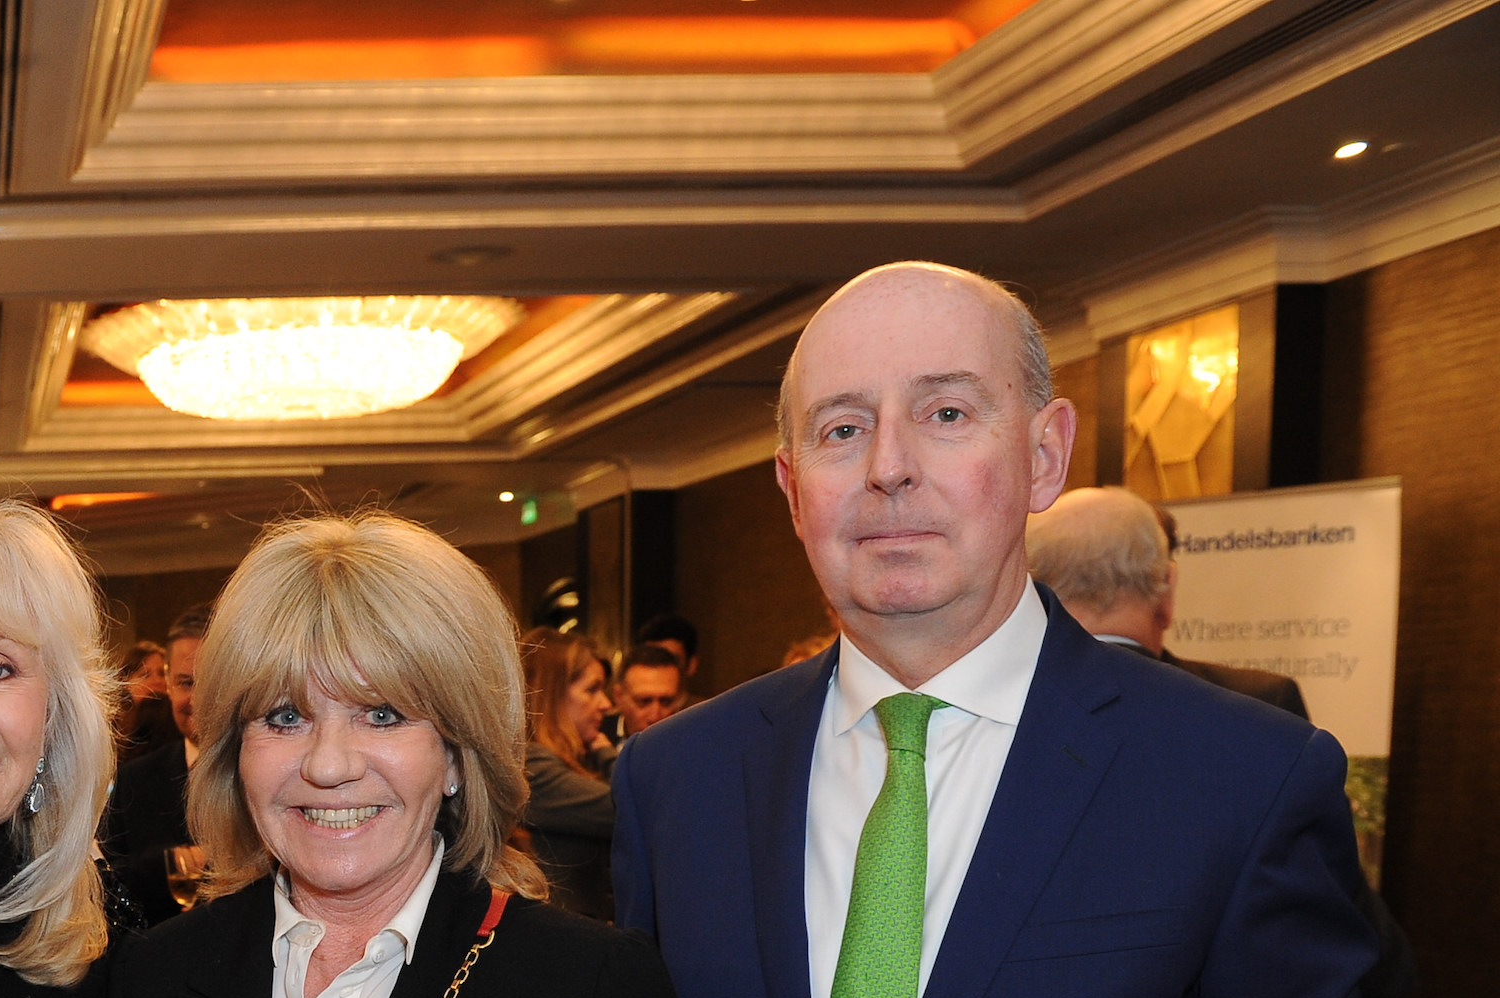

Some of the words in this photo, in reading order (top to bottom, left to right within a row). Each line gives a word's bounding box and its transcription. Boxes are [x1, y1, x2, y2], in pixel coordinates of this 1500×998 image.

[1177, 524, 1356, 554] Handelsbanken
[1173, 617, 1252, 642] Where
[1257, 615, 1350, 638] service
